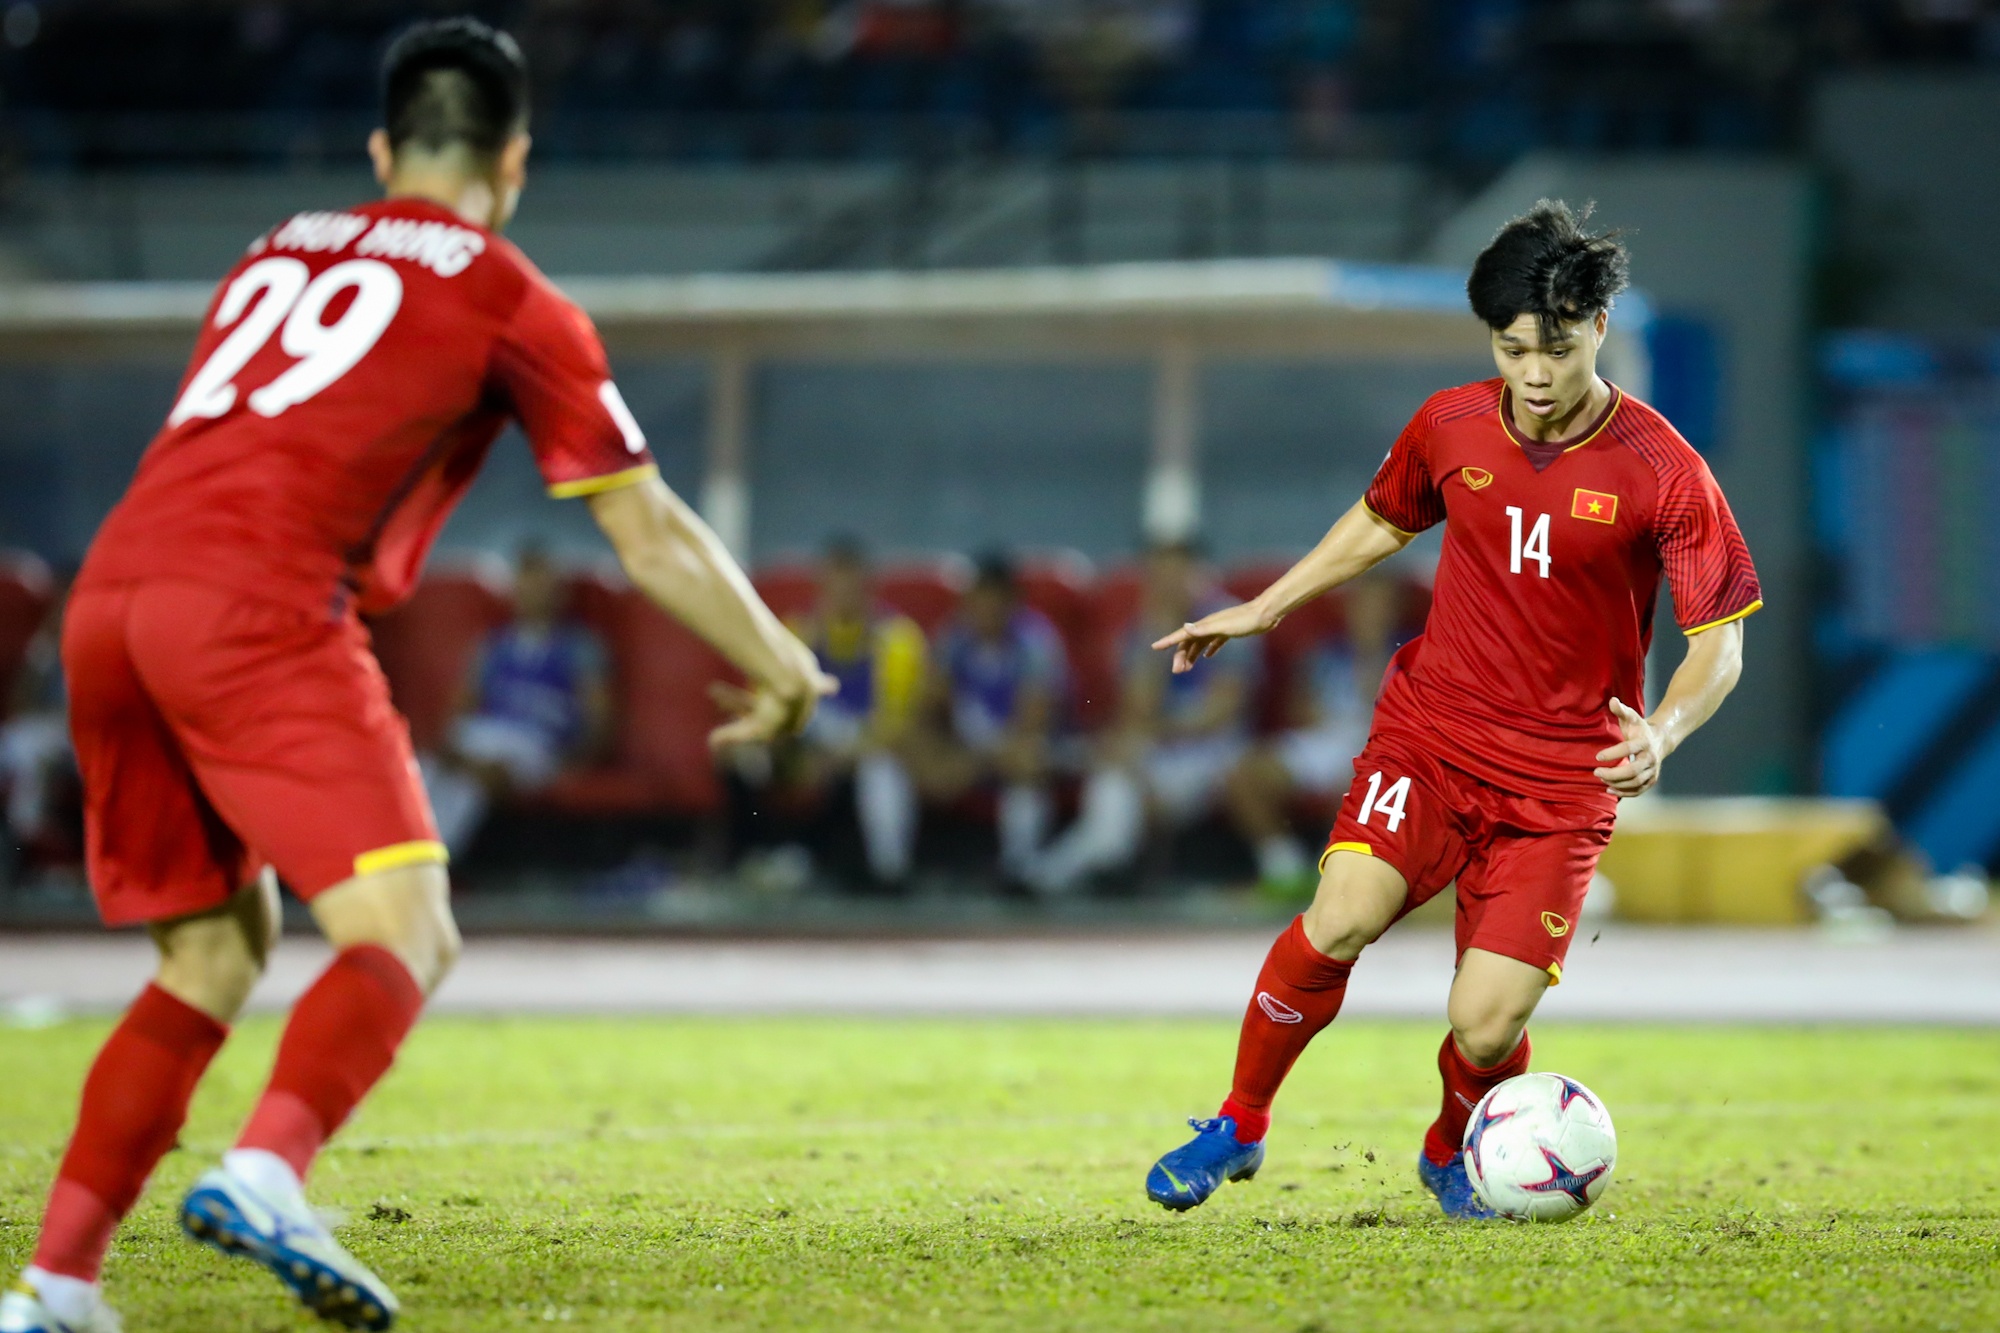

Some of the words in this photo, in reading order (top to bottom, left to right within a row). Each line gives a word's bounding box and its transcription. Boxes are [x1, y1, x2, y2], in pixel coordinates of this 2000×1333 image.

[167, 257, 404, 429] 29
[1505, 505, 1552, 579] 14
[1356, 770, 1412, 833] 14
